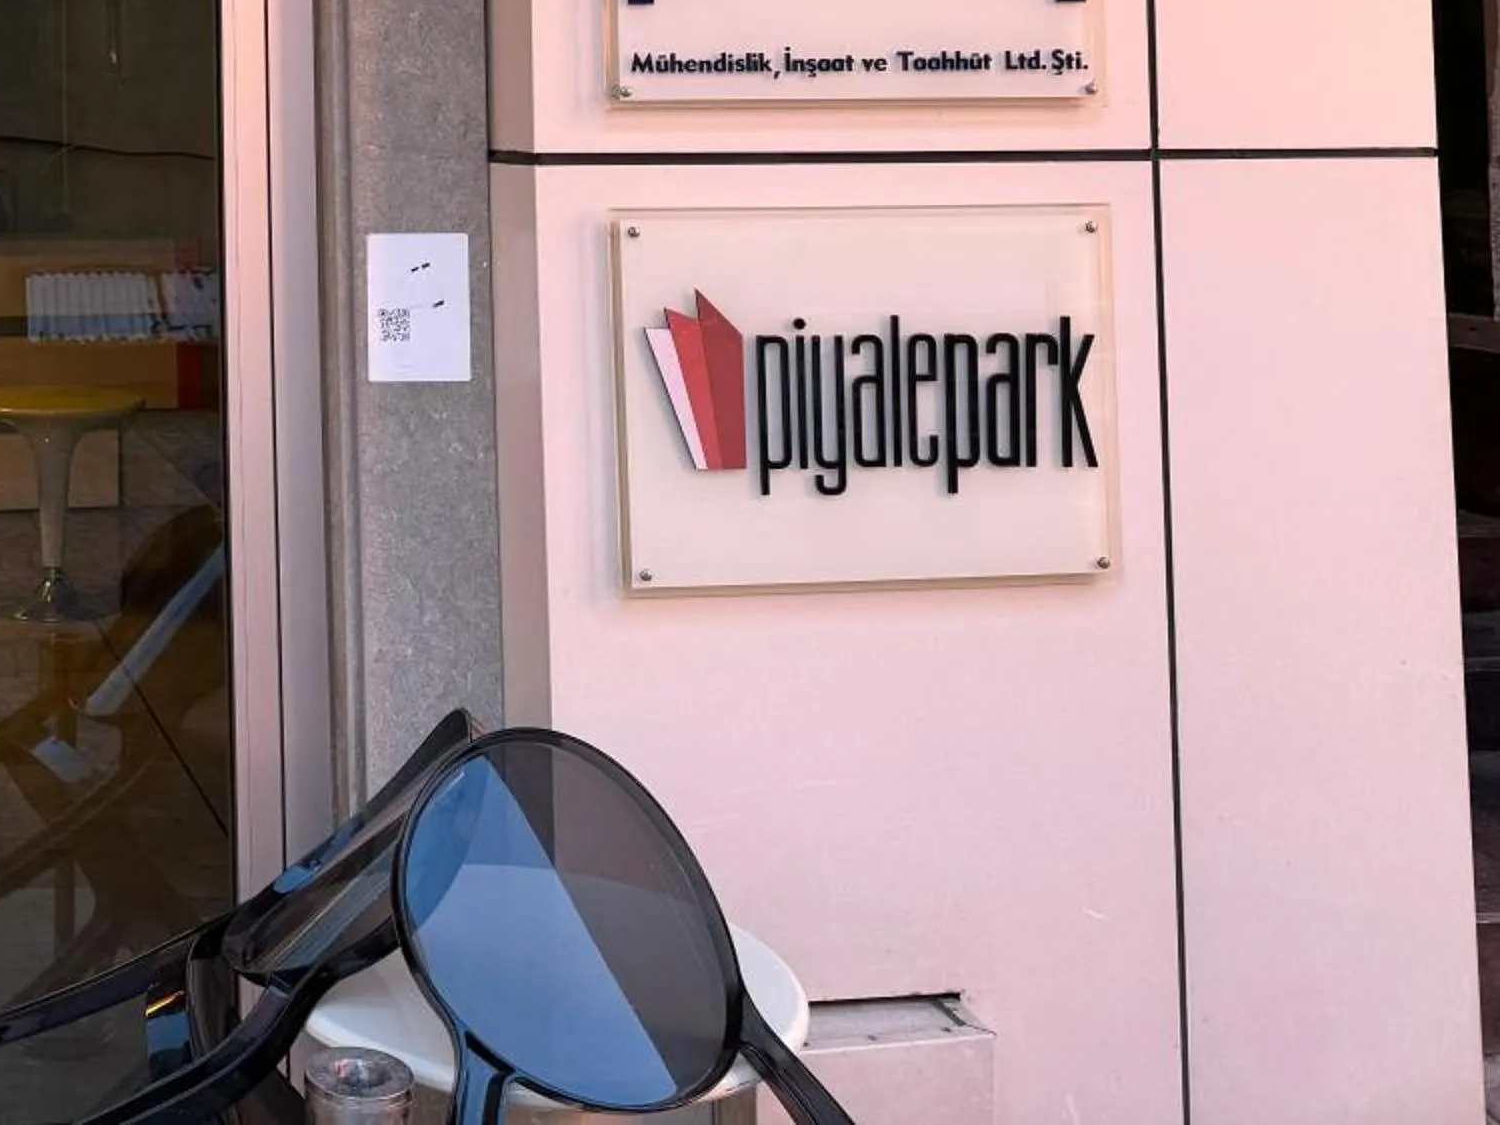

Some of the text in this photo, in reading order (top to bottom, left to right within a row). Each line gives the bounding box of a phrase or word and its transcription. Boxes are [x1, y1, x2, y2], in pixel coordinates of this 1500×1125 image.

[631, 52, 781, 79] Mühendislik,
[784, 46, 855, 77] İnşaat
[861, 57, 888, 72] ve
[896, 50, 992, 72] Taahhüt
[756, 315, 1099, 496] piyalepark
